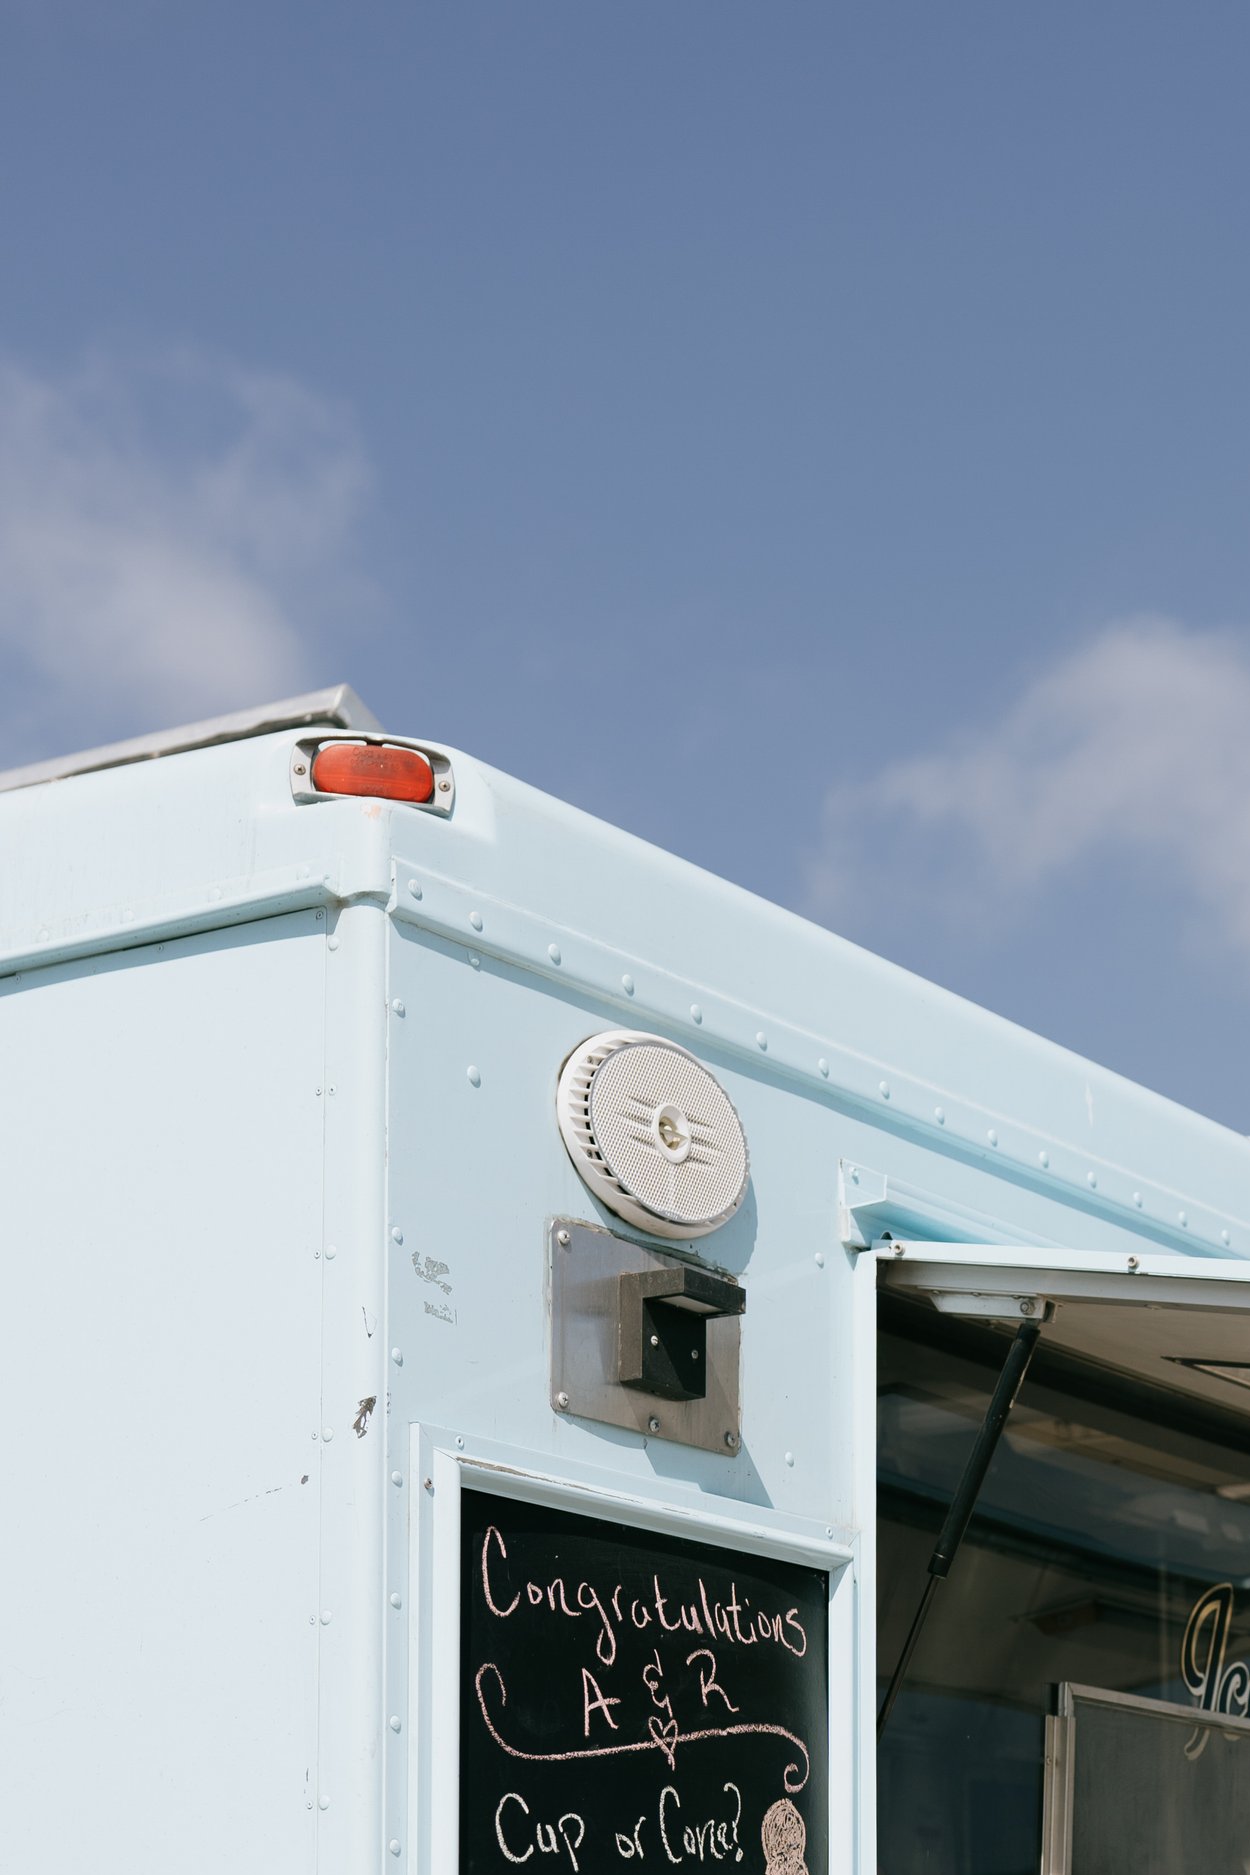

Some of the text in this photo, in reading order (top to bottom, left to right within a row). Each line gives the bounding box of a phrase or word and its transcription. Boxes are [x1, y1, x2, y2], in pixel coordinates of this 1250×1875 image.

[482, 1526, 807, 1665] Congratulations
[582, 1668, 621, 1737] A
[686, 1649, 739, 1713] R
[495, 1782, 744, 1873] Cup or Cone?
